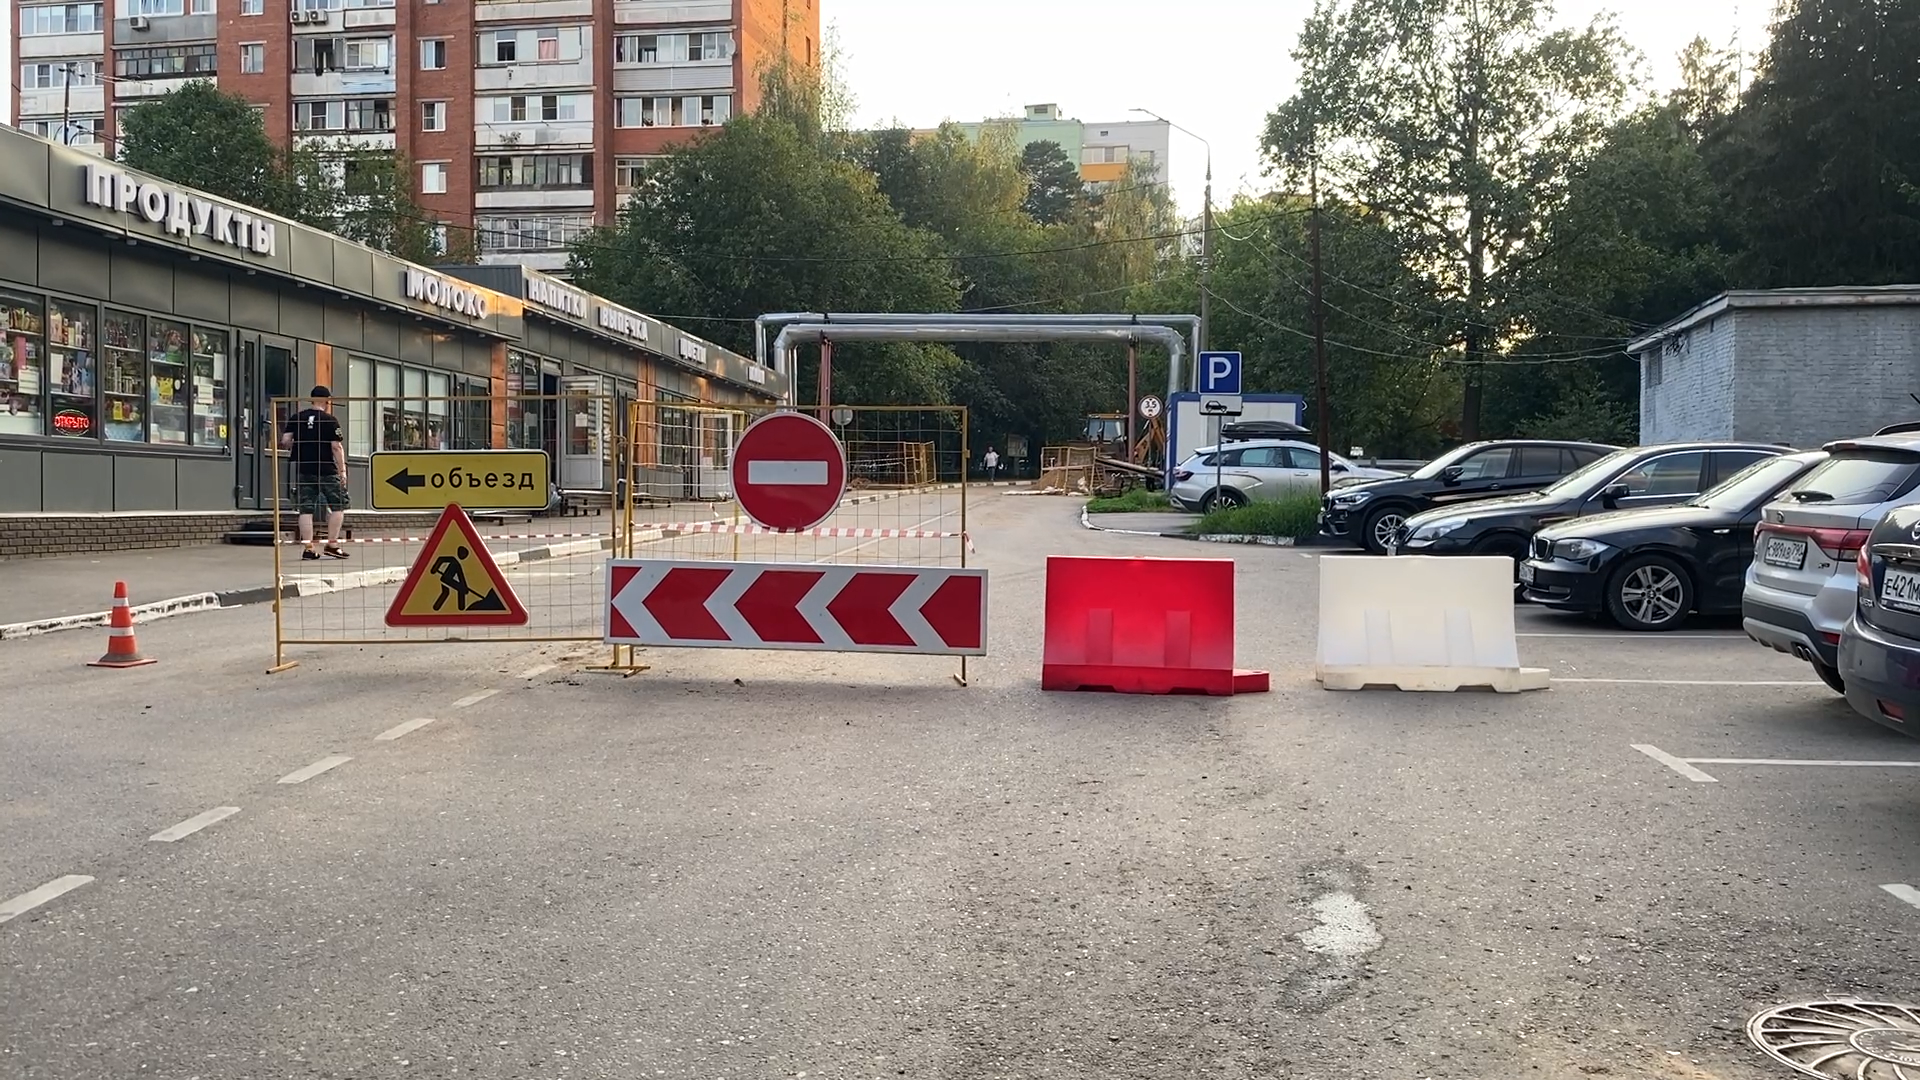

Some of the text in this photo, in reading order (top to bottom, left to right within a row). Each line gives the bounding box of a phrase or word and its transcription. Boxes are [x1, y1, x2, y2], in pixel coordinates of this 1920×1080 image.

[86, 164, 276, 257] ПРОДУКТЫ
[405, 269, 487, 320] МОЛОКО
[526, 278, 587, 319] НАПИТКИ
[598, 305, 649, 341] ВЫПЕЧКА
[1208, 356, 1232, 390] P
[54, 415, 90, 429] ОТКРЫТО
[430, 466, 535, 491] объезд
